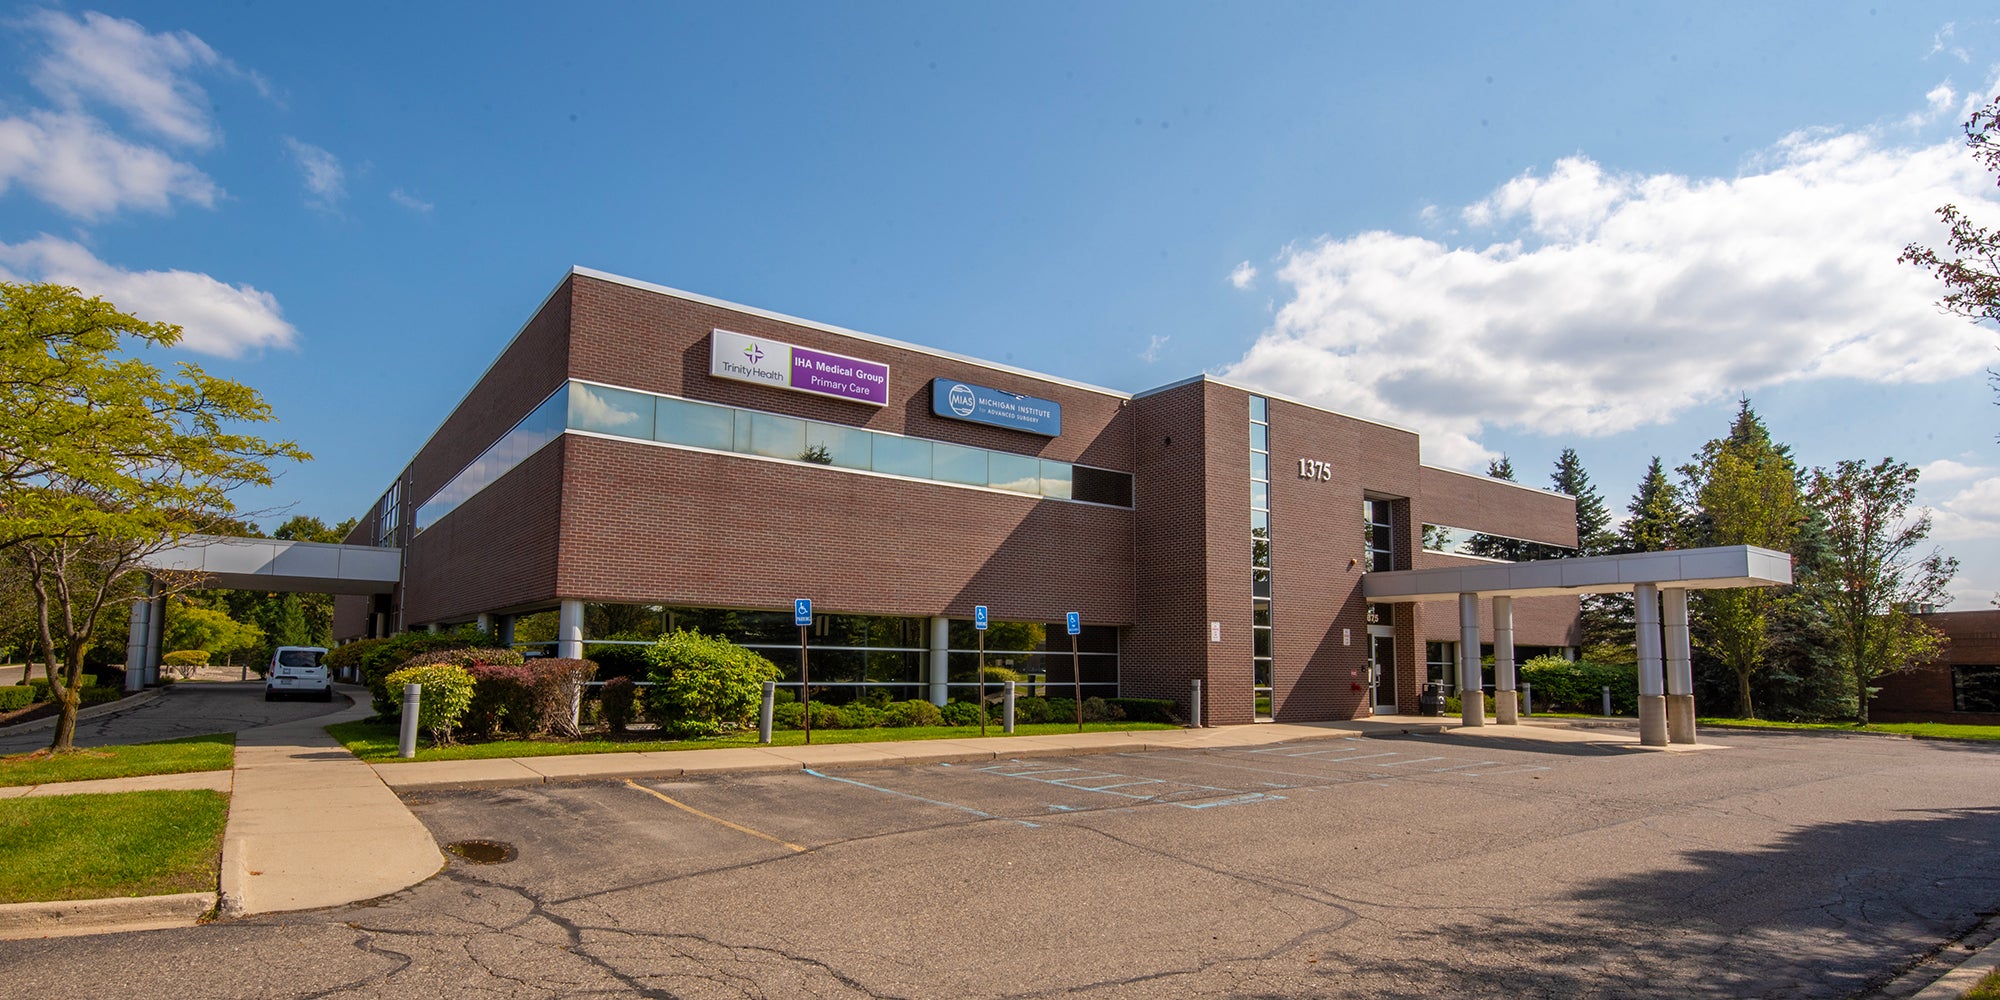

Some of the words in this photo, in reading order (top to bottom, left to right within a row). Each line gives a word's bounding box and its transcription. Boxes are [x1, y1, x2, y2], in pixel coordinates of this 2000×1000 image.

[722, 361, 752, 377] Trinity
[752, 367, 784, 381] Health
[794, 357, 813, 369] IHA
[816, 361, 853, 377] Medical
[856, 369, 884, 384] Group
[811, 375, 847, 392] Primary
[849, 383, 870, 395] Care
[951, 394, 973, 406] MIAS
[978, 397, 1016, 411] MICHIGAN
[1017, 405, 1051, 419] INSTITUTE
[987, 409, 1016, 419] ADVANCED
[1016, 414, 1039, 423] SURGERY
[1299, 458, 1331, 481] 1375
